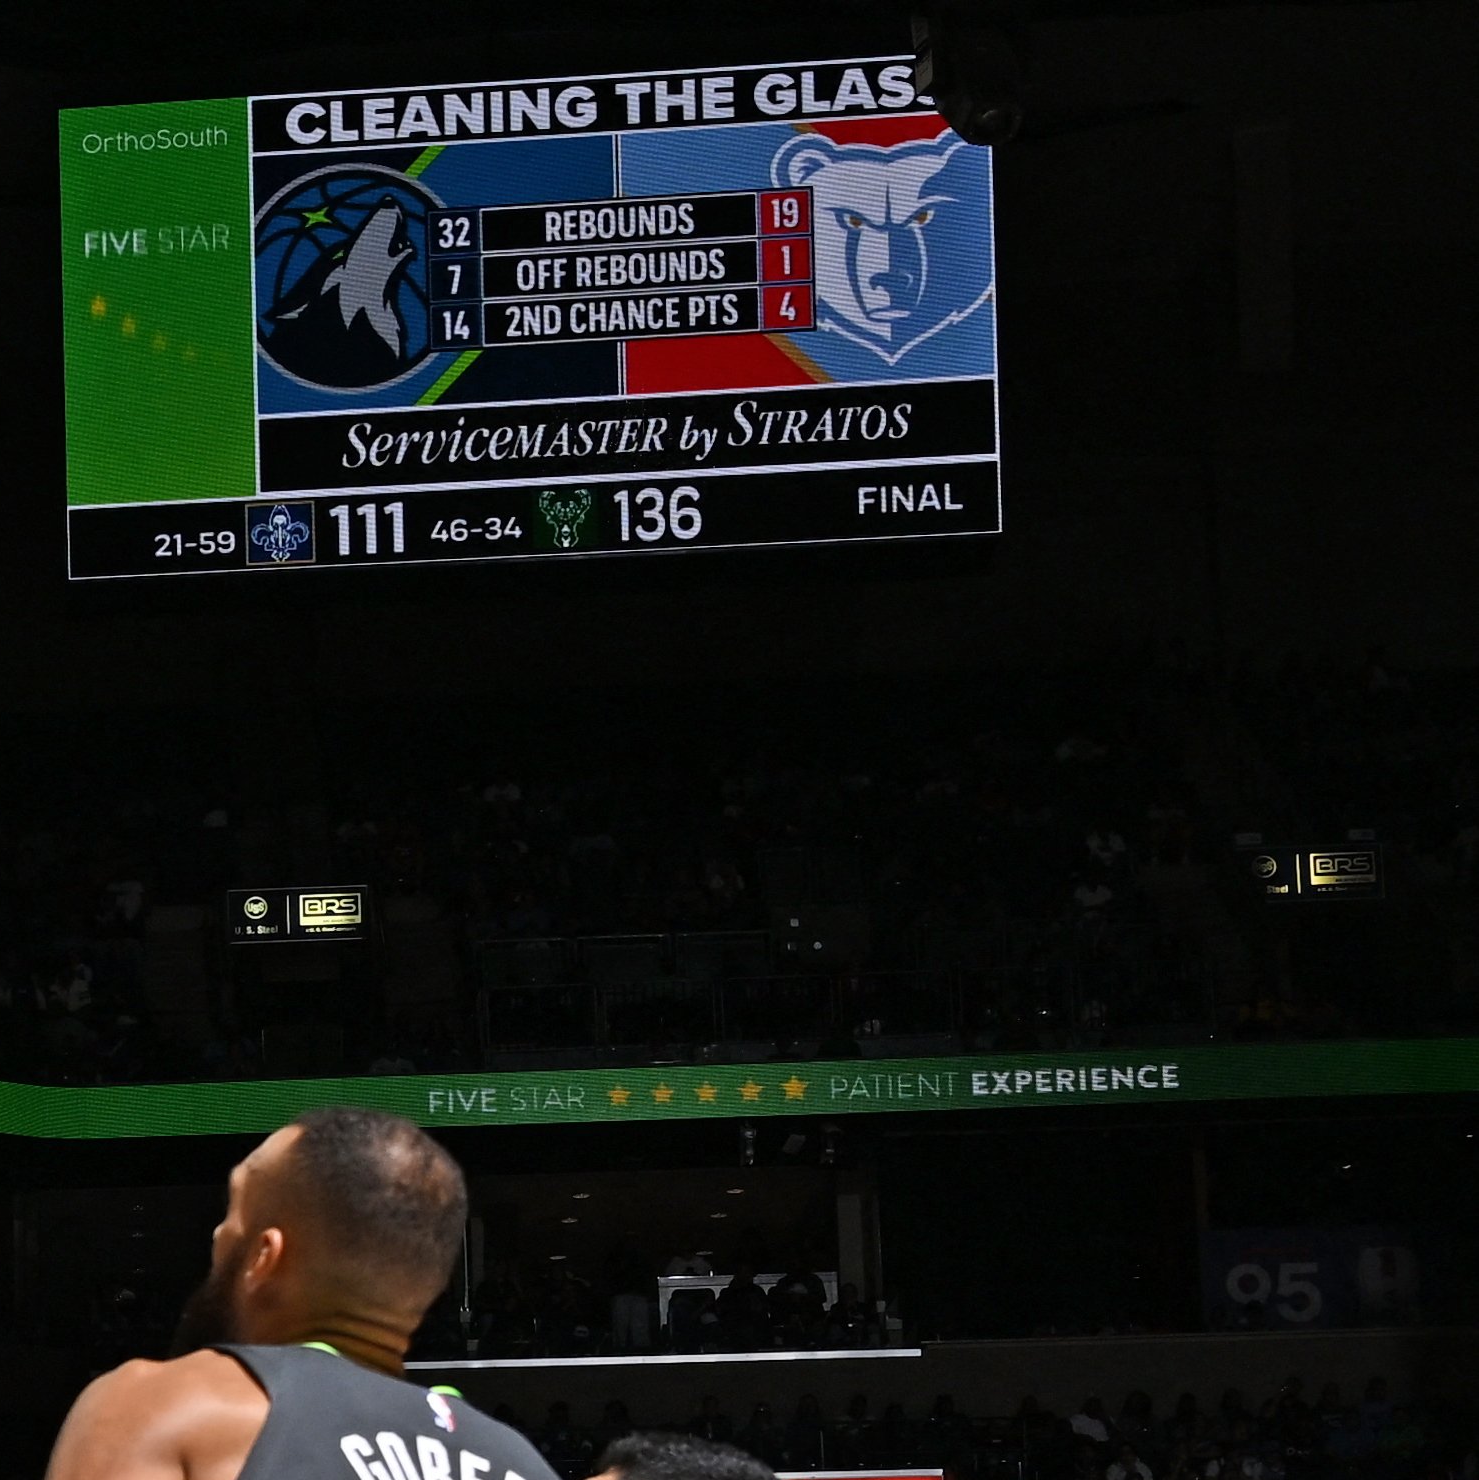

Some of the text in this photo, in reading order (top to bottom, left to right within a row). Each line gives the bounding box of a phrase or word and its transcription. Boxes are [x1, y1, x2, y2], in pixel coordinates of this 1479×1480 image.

[284, 65, 935, 145] CLEANING THE GLAS
[82, 125, 228, 154] OrthoSouth
[84, 229, 148, 258] FIVE
[438, 197, 799, 249] 32 REBOUNDS 19
[447, 245, 791, 295] 7 OFF REBOUNDS 1
[443, 291, 796, 341] 14 2ND CHANCE PTS 4
[680, 417, 719, 462] by
[154, 483, 963, 558] 21-59 111 46-34 136 FINAL
[1314, 858, 1372, 875] BRS
[304, 899, 357, 915] BRS
[428, 1065, 1181, 1114] FIVE STAR PATIENT EXPERIENCE
